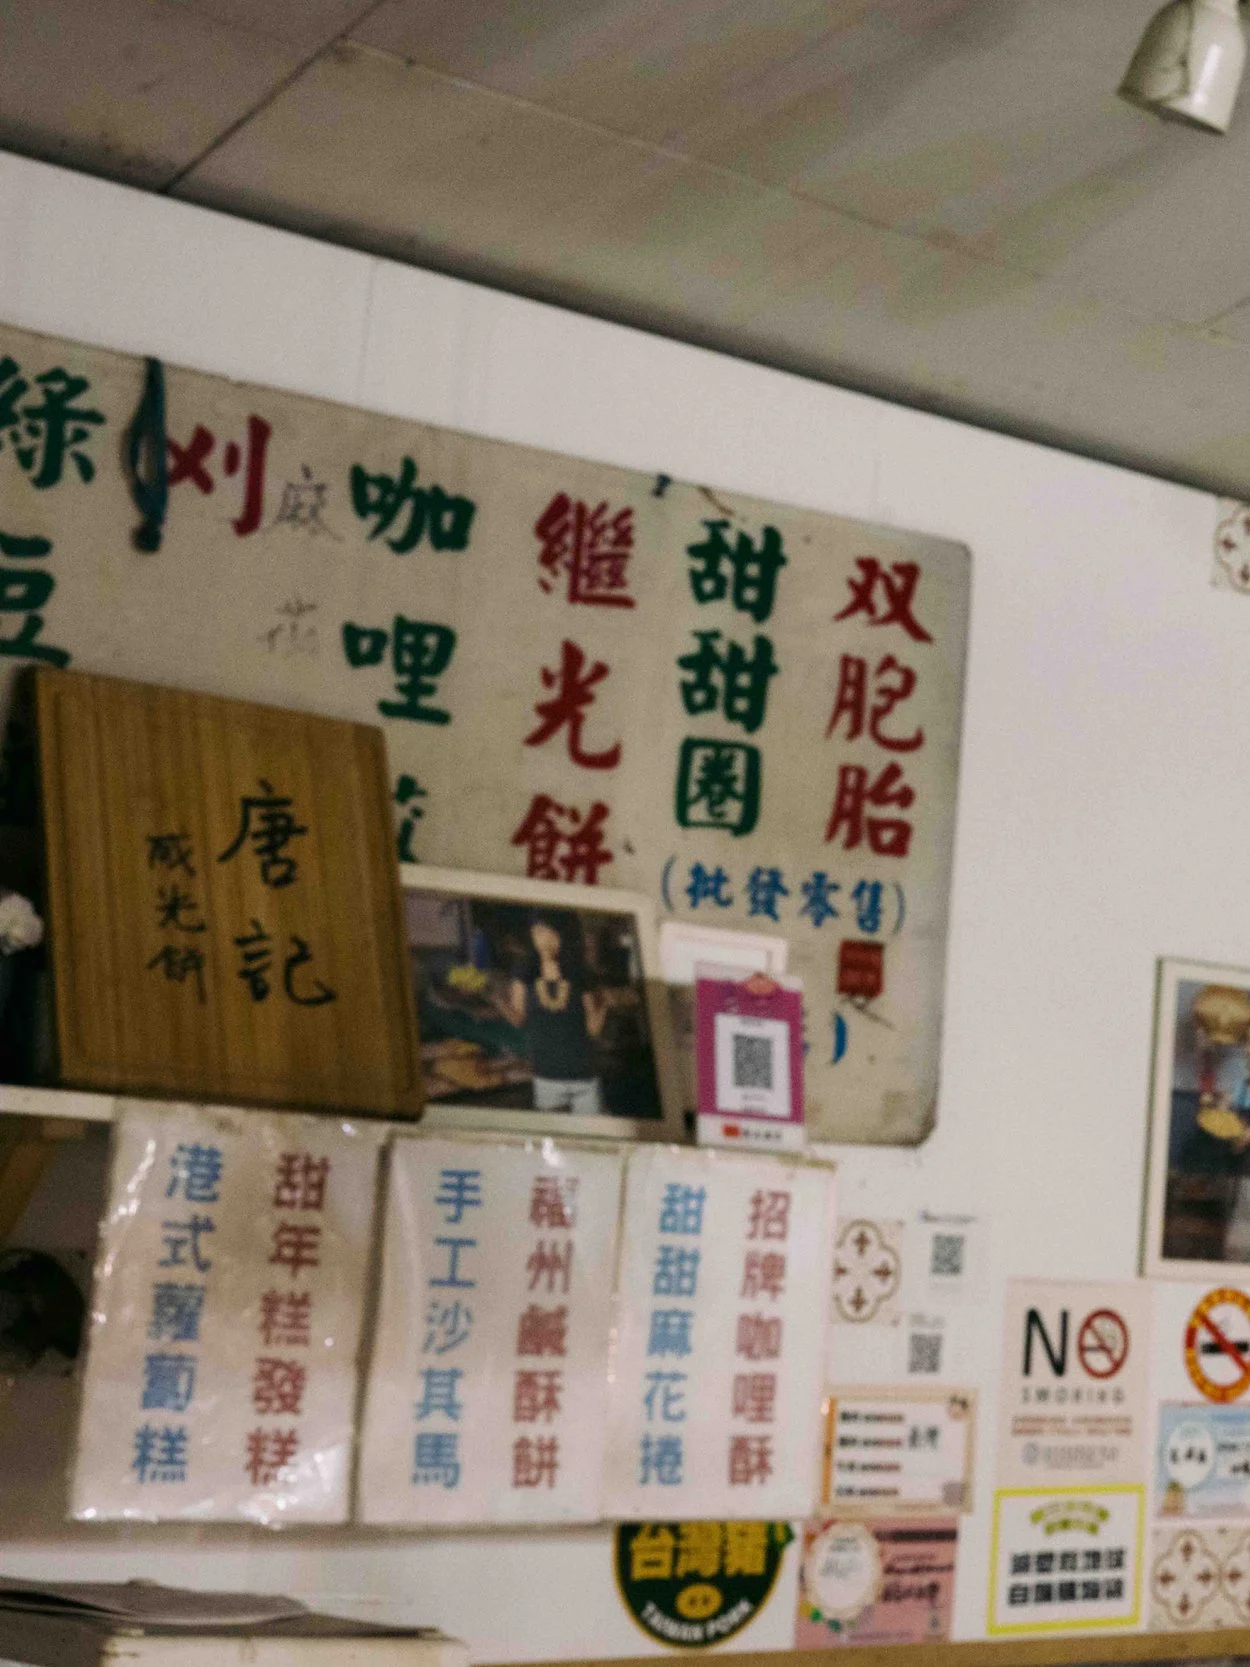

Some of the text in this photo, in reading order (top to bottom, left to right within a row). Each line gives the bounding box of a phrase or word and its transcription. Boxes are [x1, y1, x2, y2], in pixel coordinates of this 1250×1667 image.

[512, 493, 637, 886] 繼光餅
[676, 518, 787, 837] 甜甜圈
[825, 557, 934, 858] 双胞胎
[218, 778, 336, 1006] 唐記
[132, 1143, 223, 1486] 港式蘿蔔糕
[244, 1150, 330, 1486] 甜年糕發糕
[411, 1168, 483, 1489] 手工沙其馬
[638, 1181, 706, 1488] 甜甜麻花捲
[729, 1188, 791, 1488] 招牌咖哩酥
